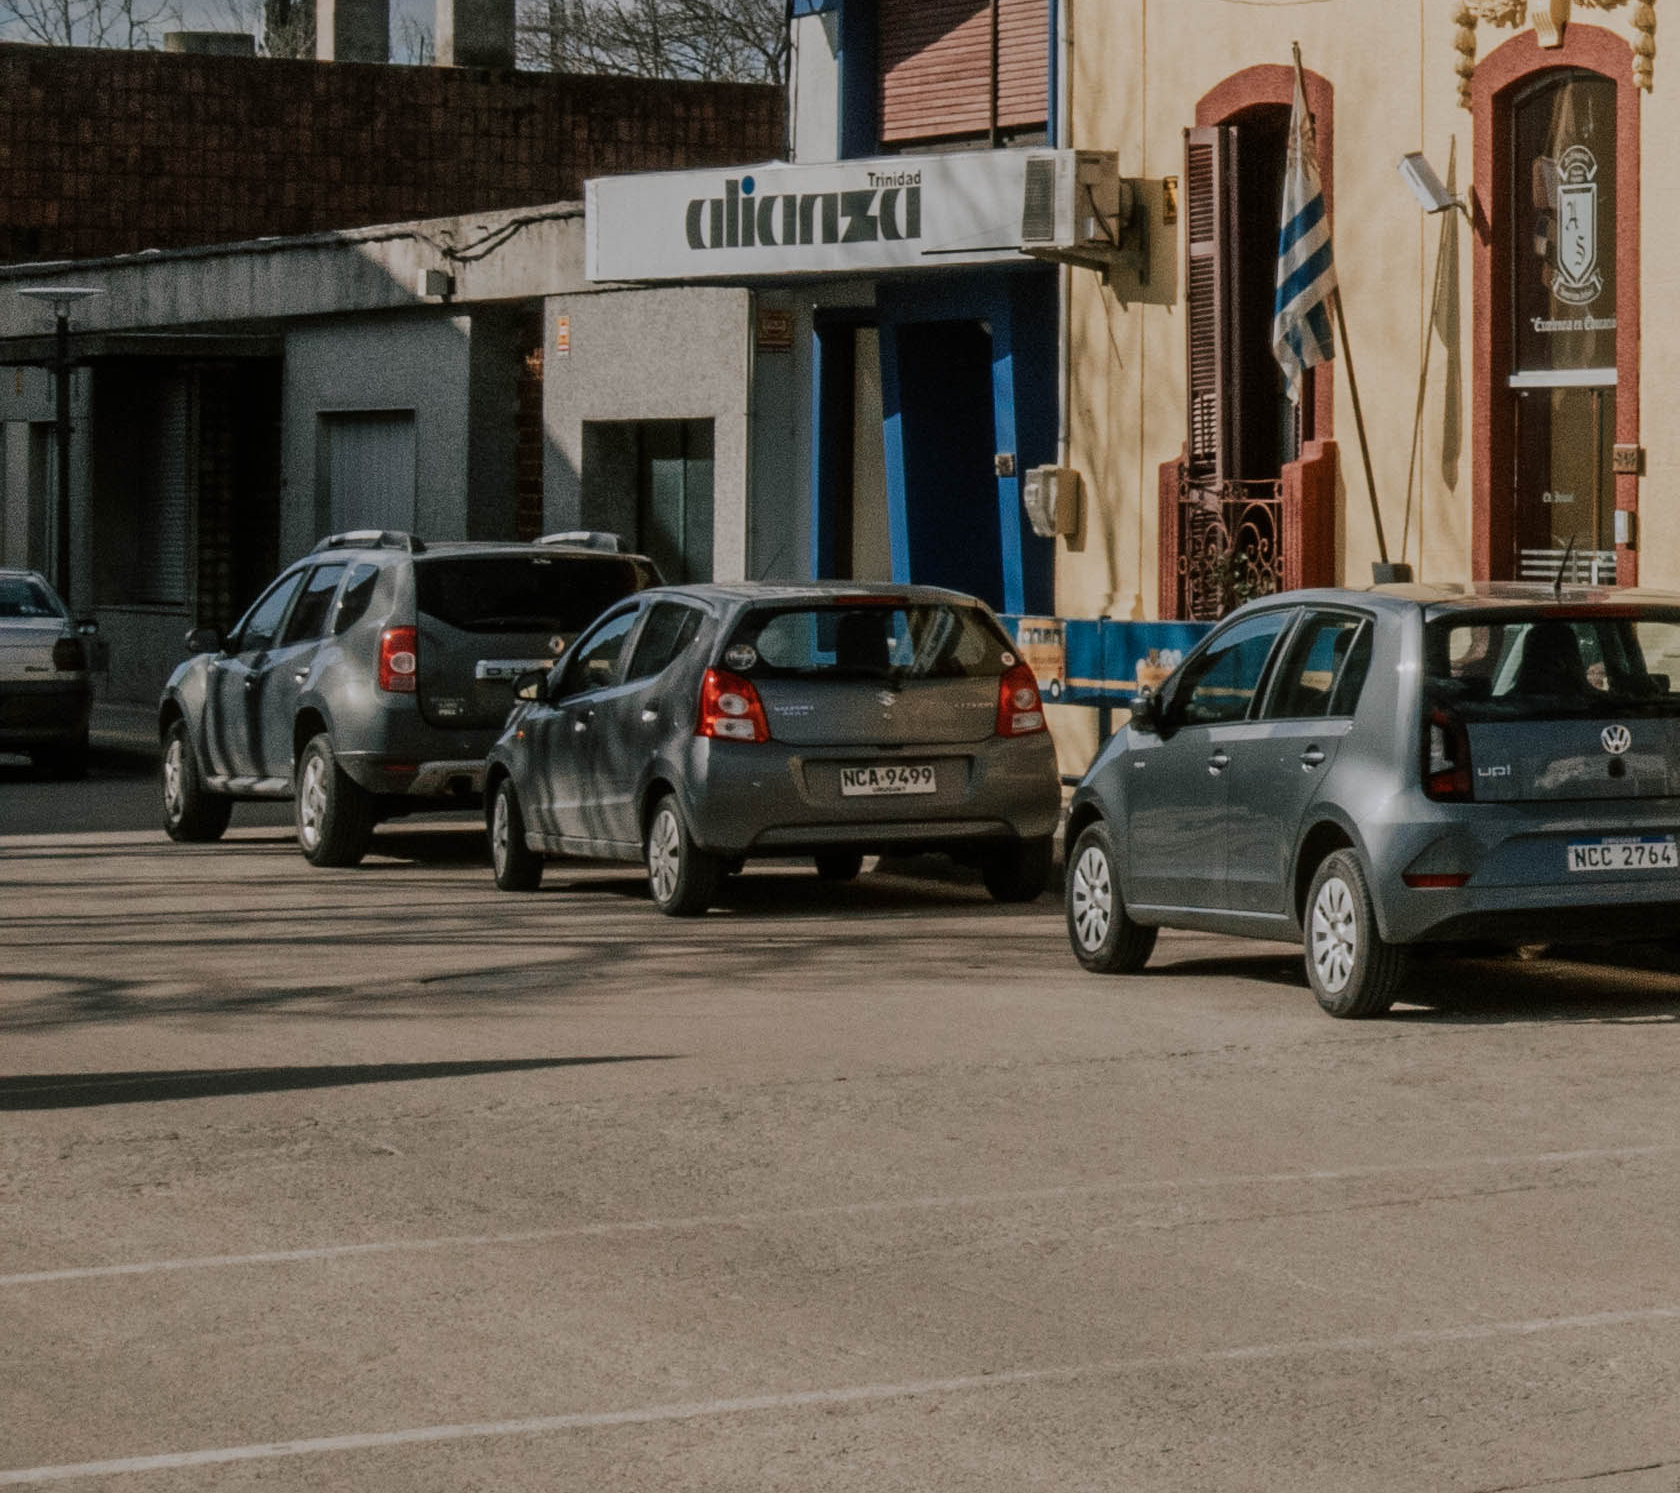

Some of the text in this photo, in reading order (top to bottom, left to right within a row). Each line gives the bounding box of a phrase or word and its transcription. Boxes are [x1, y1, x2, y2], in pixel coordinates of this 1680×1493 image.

[867, 169, 922, 188] Trinidad
[685, 174, 922, 251] alianza
[1574, 844, 1672, 868] NCC 2764
